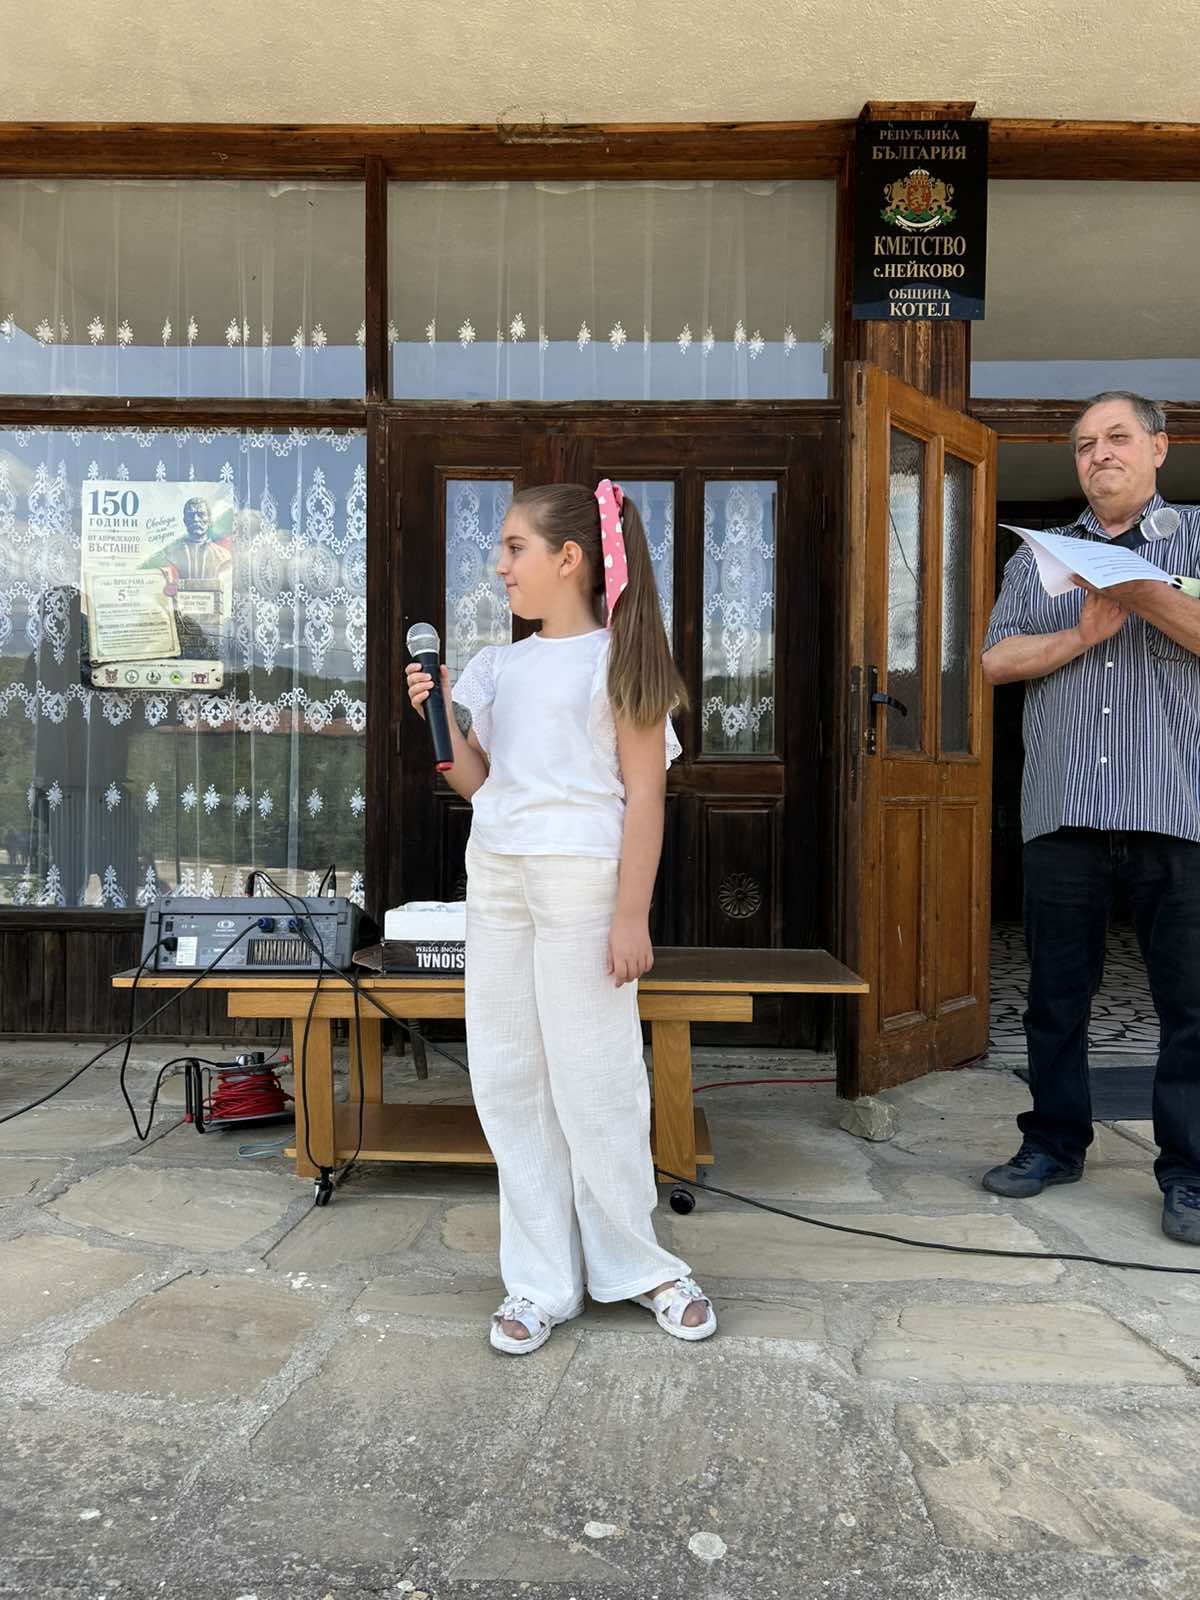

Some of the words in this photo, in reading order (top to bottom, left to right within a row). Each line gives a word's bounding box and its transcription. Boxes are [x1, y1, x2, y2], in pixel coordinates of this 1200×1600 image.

[879, 129, 960, 141] РЕПУБЛИКА
[872, 146, 968, 160] БЪЛГАРИЯ
[874, 236, 967, 257] КМЕТСТВО
[873, 260, 966, 278] с.НЕЙКОВО
[889, 288, 951, 301] ОБЩИНА
[890, 302, 951, 317] КОТЕЛ
[88, 489, 140, 517] 150
[89, 518, 138, 528] ГОДИНИ
[88, 543, 141, 553] ВЪСТАНИЕ
[118, 589, 126, 602] 5
